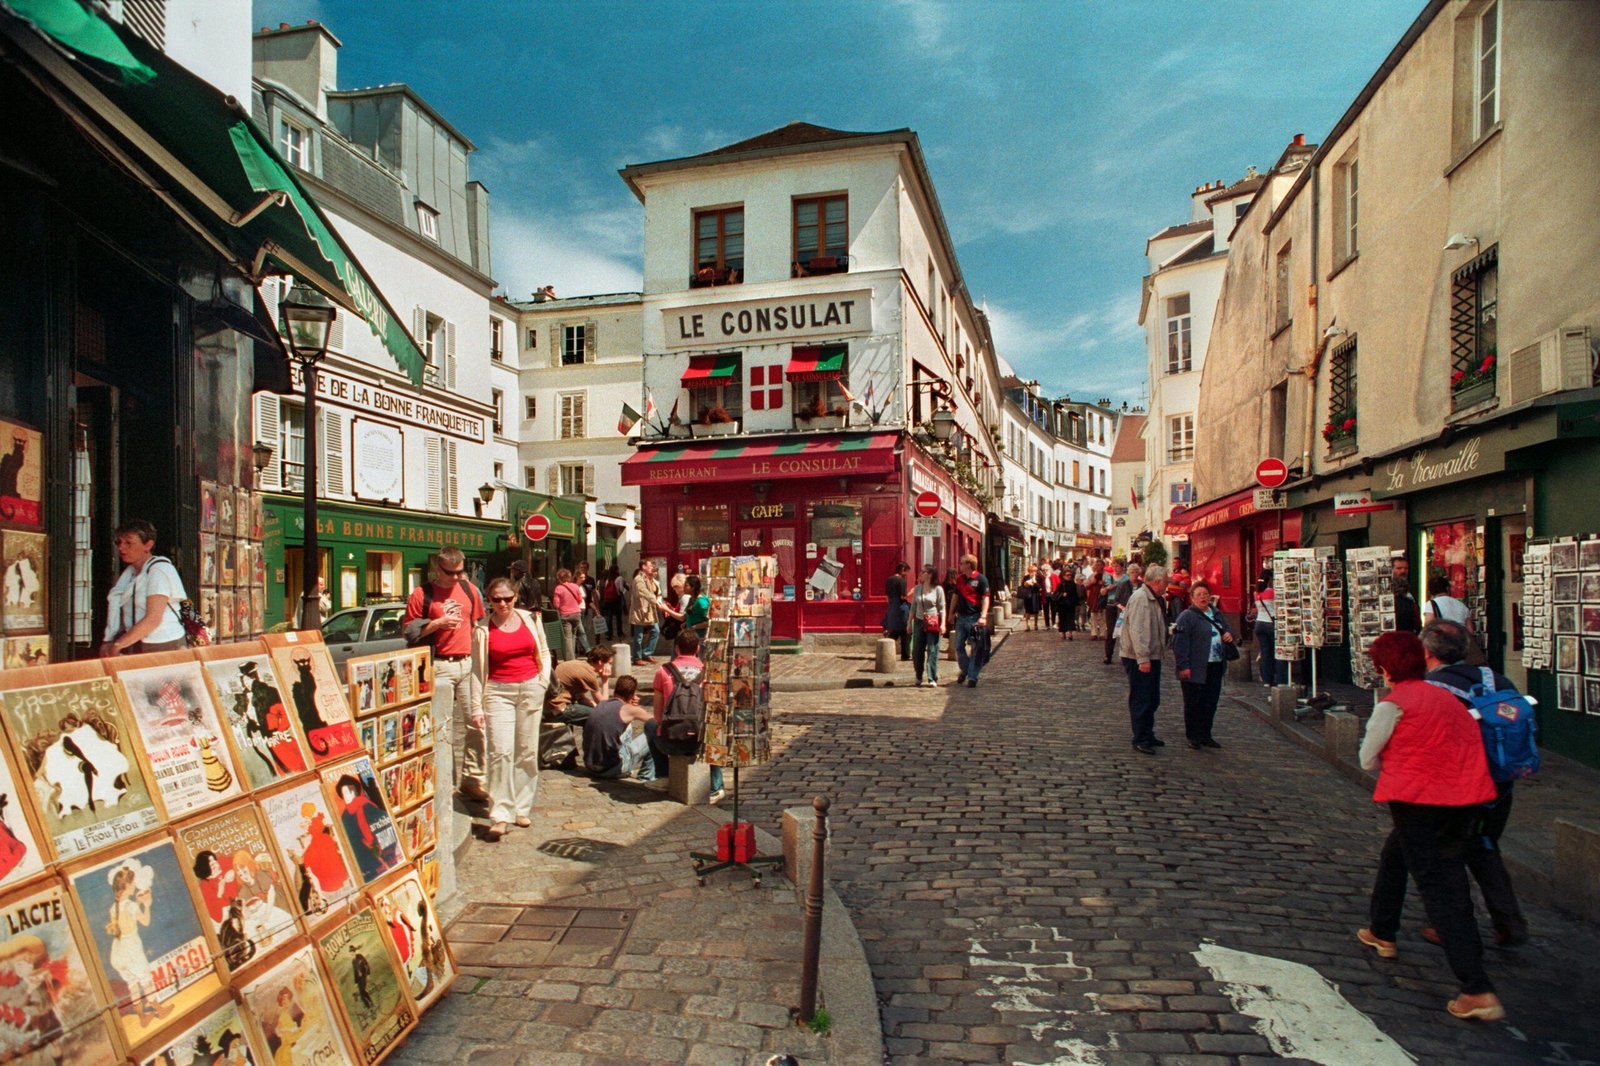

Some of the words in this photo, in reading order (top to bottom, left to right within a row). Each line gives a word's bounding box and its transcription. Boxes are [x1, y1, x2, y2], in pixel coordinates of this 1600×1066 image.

[679, 314, 705, 339] LE
[721, 301, 855, 336] CONSULAT
[331, 379, 348, 399] DE
[353, 385, 370, 406] LA
[374, 392, 413, 418] BONNE
[416, 402, 480, 436] FRANQUETTE
[650, 466, 718, 480] RESTAURANT
[752, 462, 770, 475] LE
[779, 456, 862, 474] CONSULAT
[1386, 460, 1404, 491] La
[1411, 436, 1481, 485] Trouvaille
[751, 502, 783, 519] CAFÉ
[316, 519, 335, 534] LA
[343, 521, 394, 539] BONNE
[400, 526, 484, 547] FRANQUETTE
[184, 816, 239, 843] COMPAGNIE
[325, 925, 351, 960] HOWE
[151, 944, 208, 992] MAGGI
